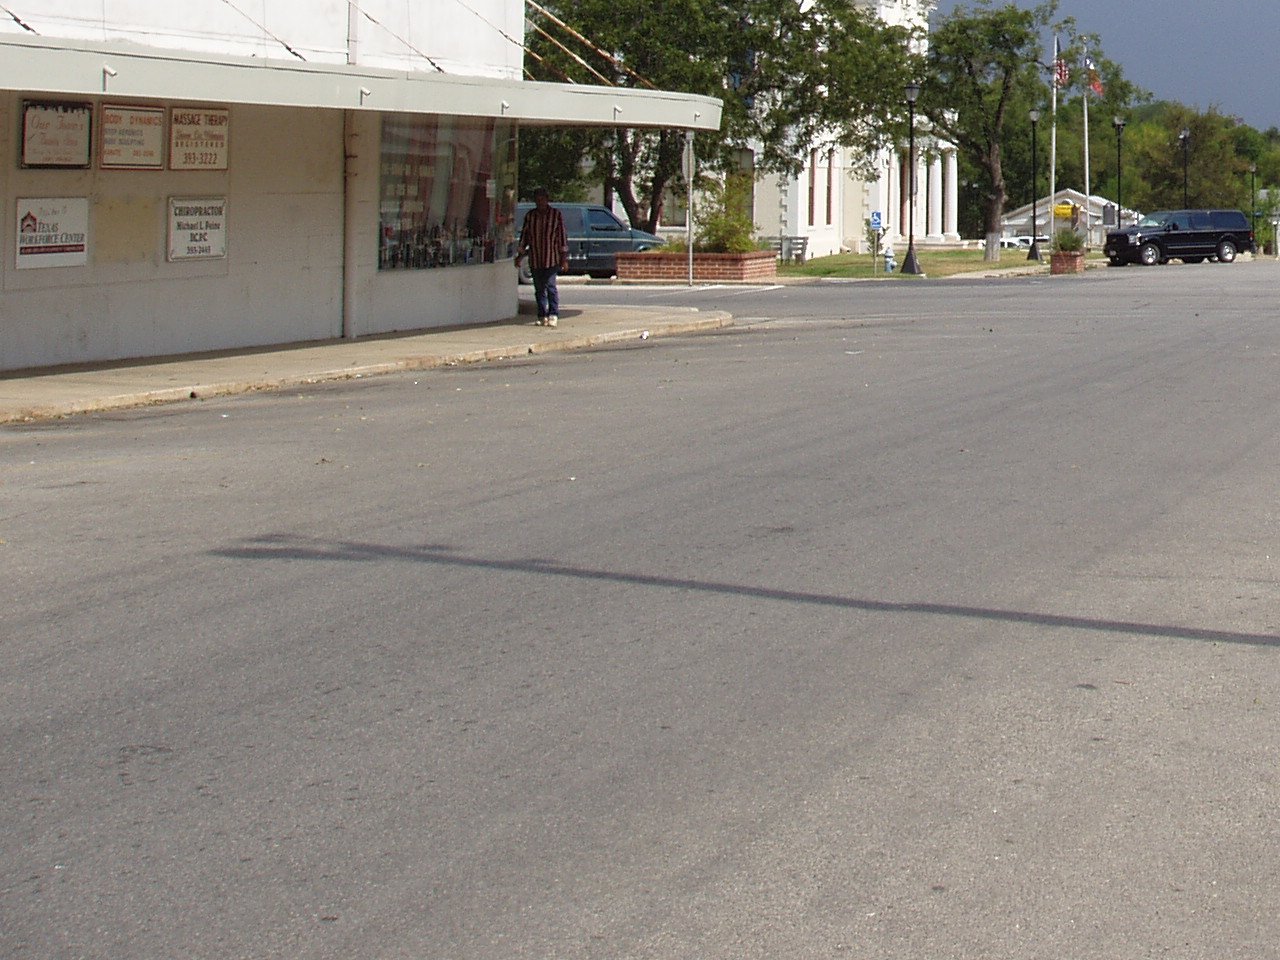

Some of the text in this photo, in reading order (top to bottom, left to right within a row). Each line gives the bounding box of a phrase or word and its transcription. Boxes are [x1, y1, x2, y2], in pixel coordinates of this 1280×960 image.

[174, 113, 228, 127] MASSAGE THERAPY
[174, 206, 223, 217] CHIROPRACTOR
[37, 221, 59, 233] TEXAS
[20, 232, 85, 244] WORKFORCE CENTER
